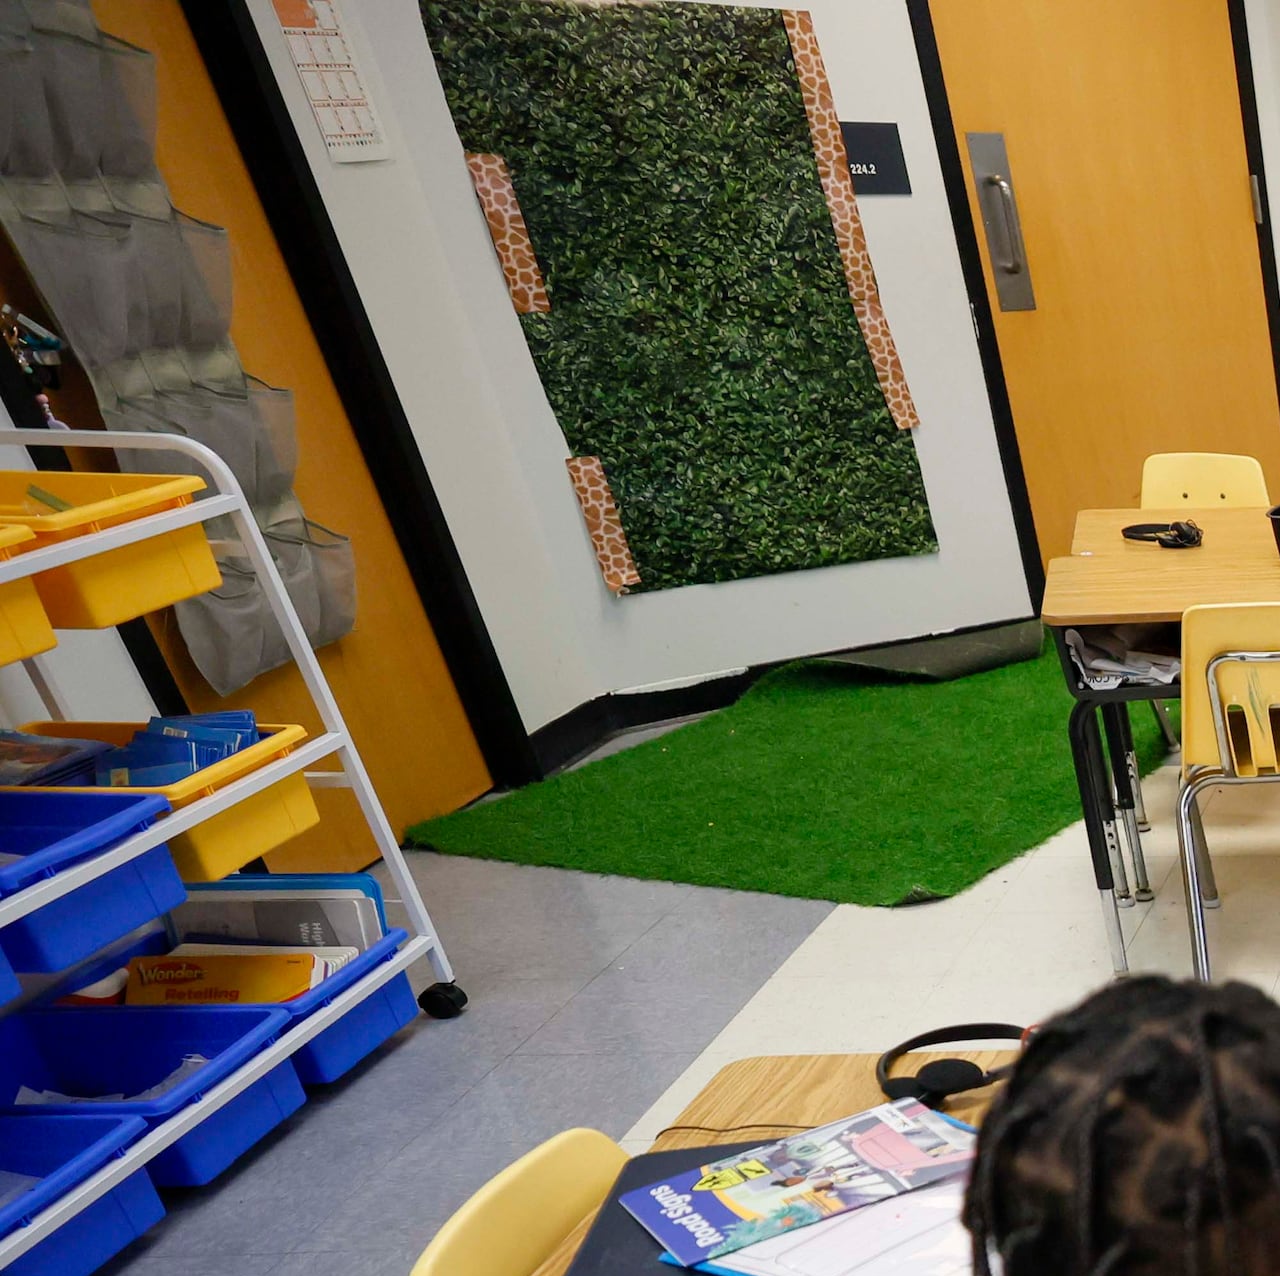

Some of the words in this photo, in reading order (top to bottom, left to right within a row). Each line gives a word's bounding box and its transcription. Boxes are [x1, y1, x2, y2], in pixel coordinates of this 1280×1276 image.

[138, 961, 208, 986] Wonders
[165, 987, 240, 1002] Retelling
[650, 1184, 693, 1219] Signs
[672, 1212, 725, 1248] Road
